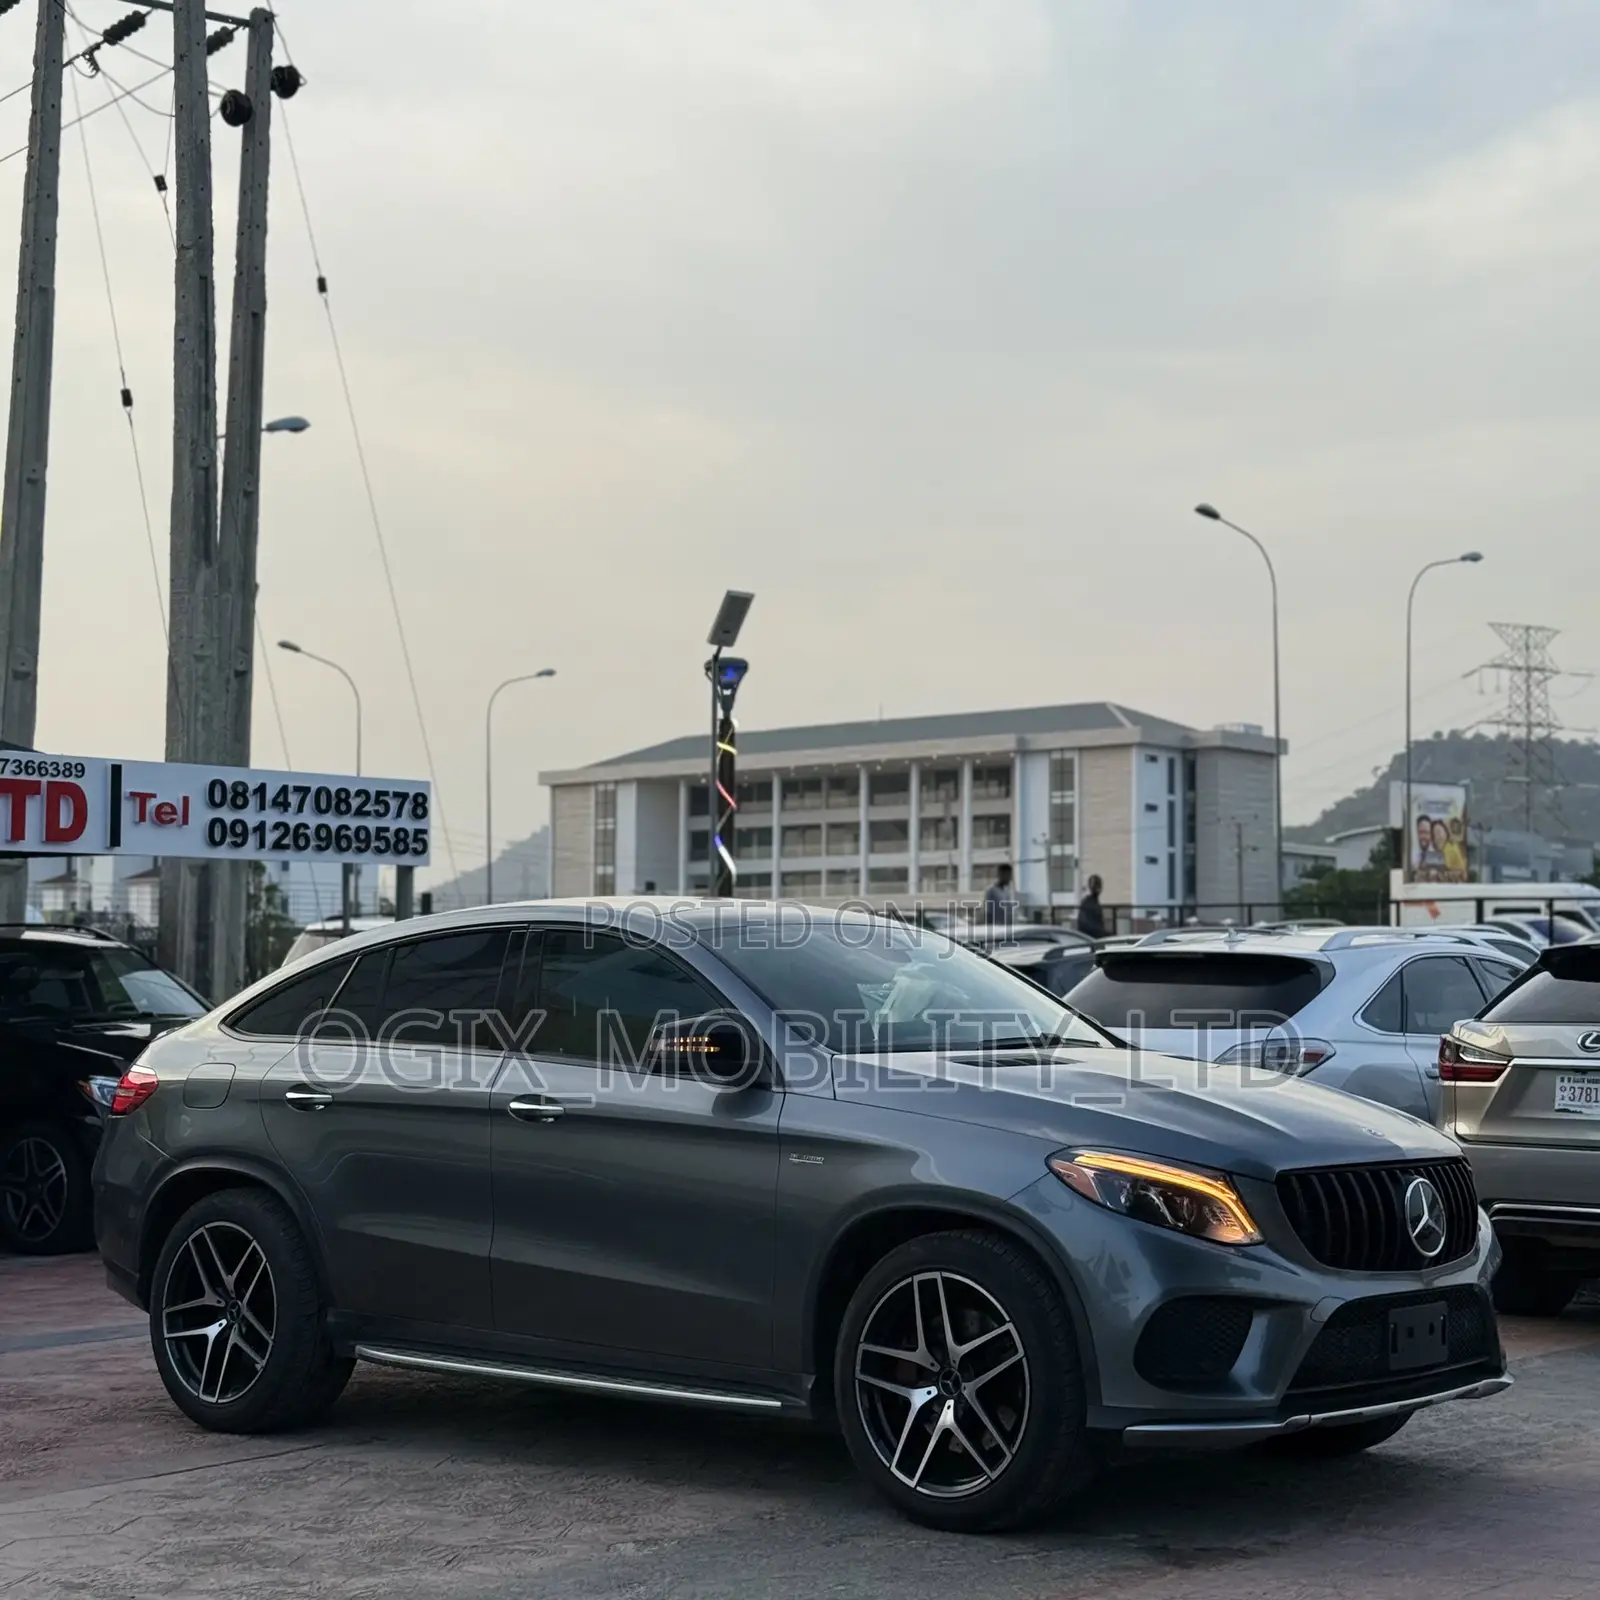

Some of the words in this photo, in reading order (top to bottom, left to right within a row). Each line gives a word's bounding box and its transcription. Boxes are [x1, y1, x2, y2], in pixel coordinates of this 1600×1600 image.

[0, 758, 86, 778] 7366389
[0, 778, 88, 843] TD
[129, 791, 190, 826] Tel
[207, 778, 429, 820] 08147082578
[207, 817, 429, 856] 09126969585
